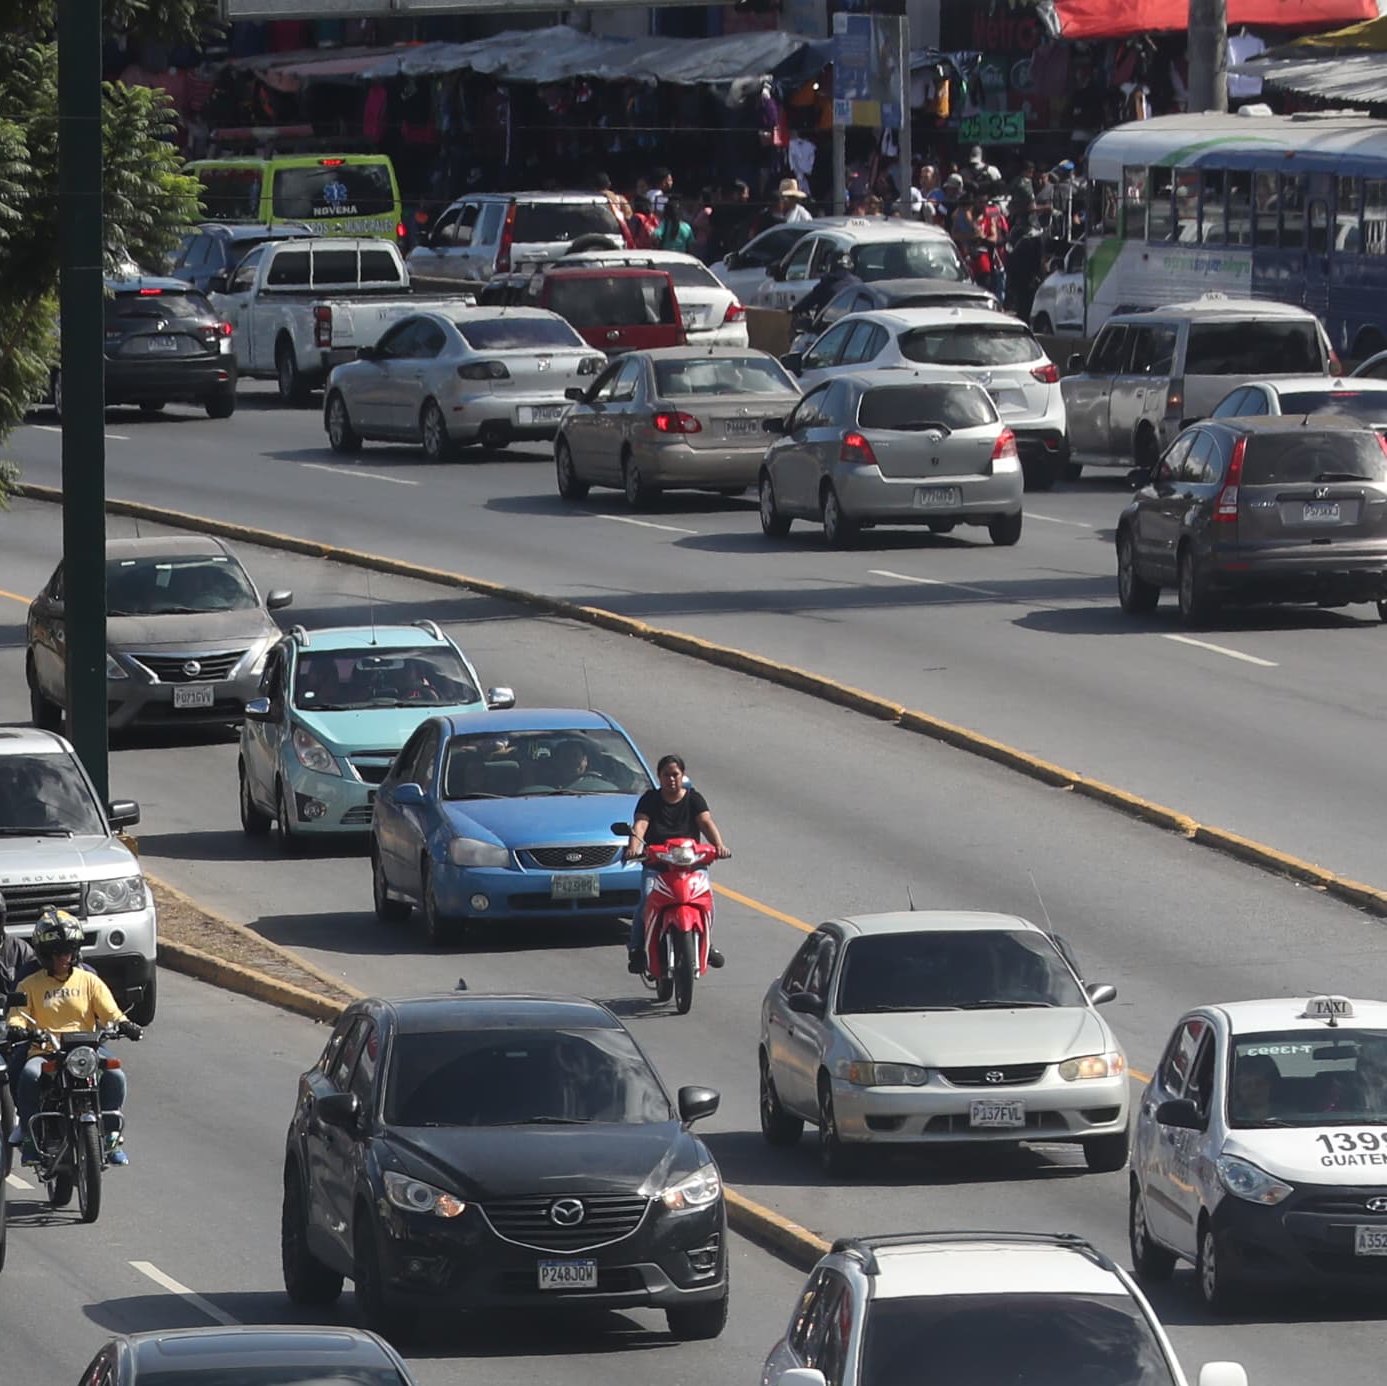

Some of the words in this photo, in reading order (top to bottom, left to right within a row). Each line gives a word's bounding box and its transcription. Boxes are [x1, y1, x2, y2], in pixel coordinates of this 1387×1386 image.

[988, 116, 1018, 141] 35
[313, 204, 358, 217] NOVENA
[21, 874, 79, 883] ROVER
[43, 987, 80, 1000] AERO
[1314, 1001, 1346, 1014] TAXI
[972, 1107, 1021, 1121] P137FVL
[1315, 1132, 1387, 1154] 139
